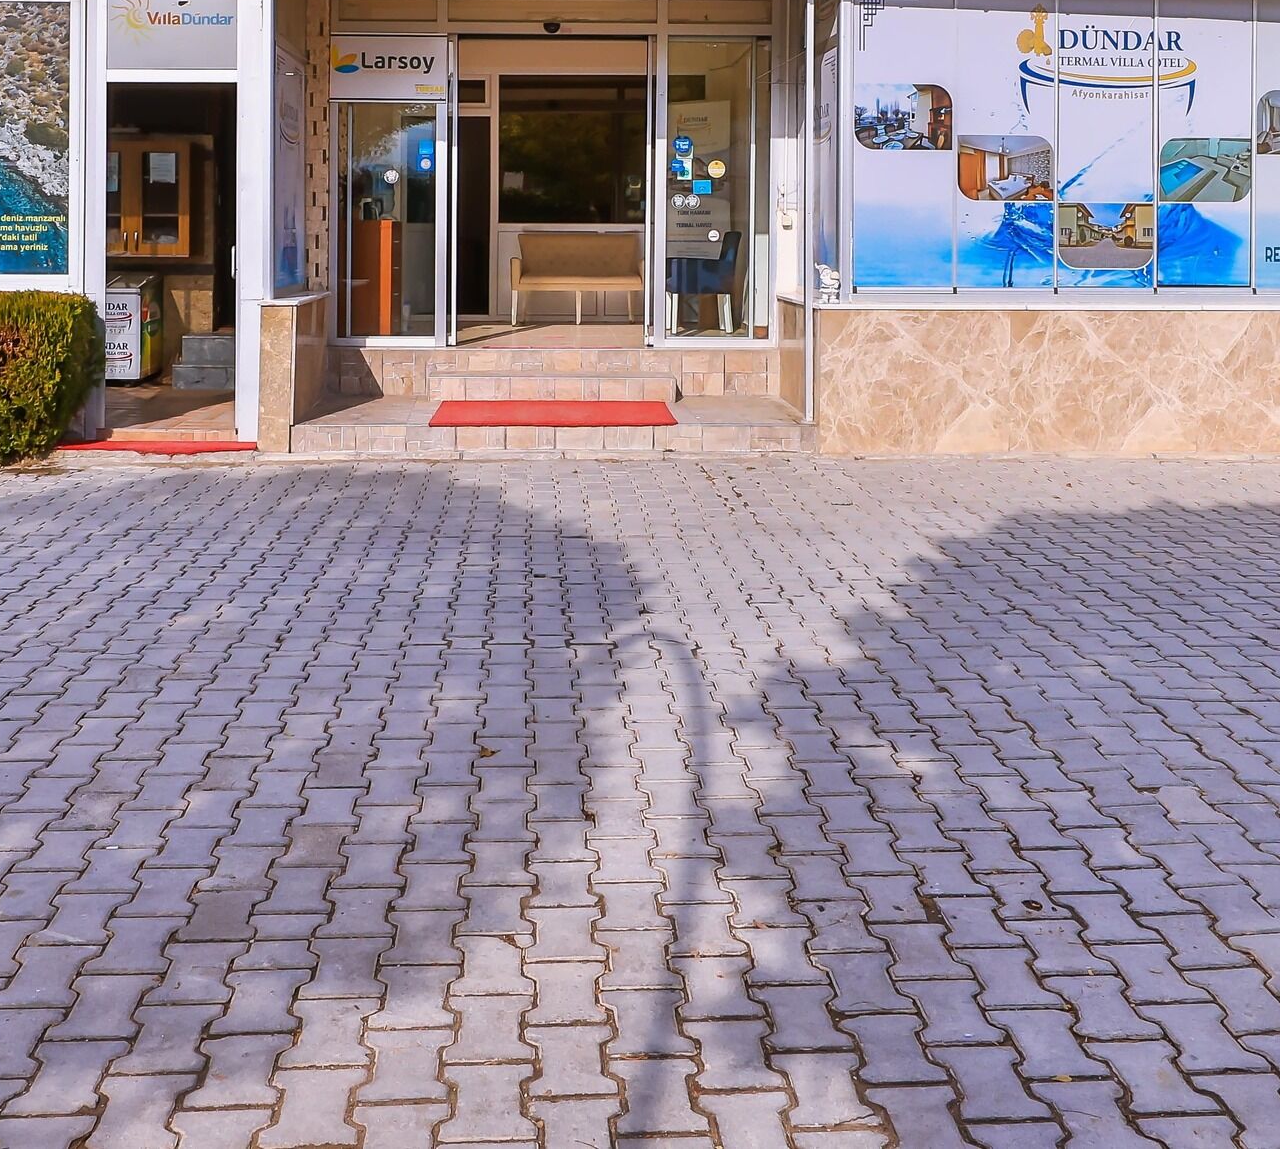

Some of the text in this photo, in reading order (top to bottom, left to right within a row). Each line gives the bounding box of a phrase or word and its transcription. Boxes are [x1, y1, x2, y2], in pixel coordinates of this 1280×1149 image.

[1059, 25, 1184, 51] DÜNDAR
[361, 51, 435, 74] Larsoy
[1059, 56, 1108, 66] TERMAL
[1072, 89, 1150, 100] Afyonkarahisar
[20, 243, 49, 252] yeriniz
